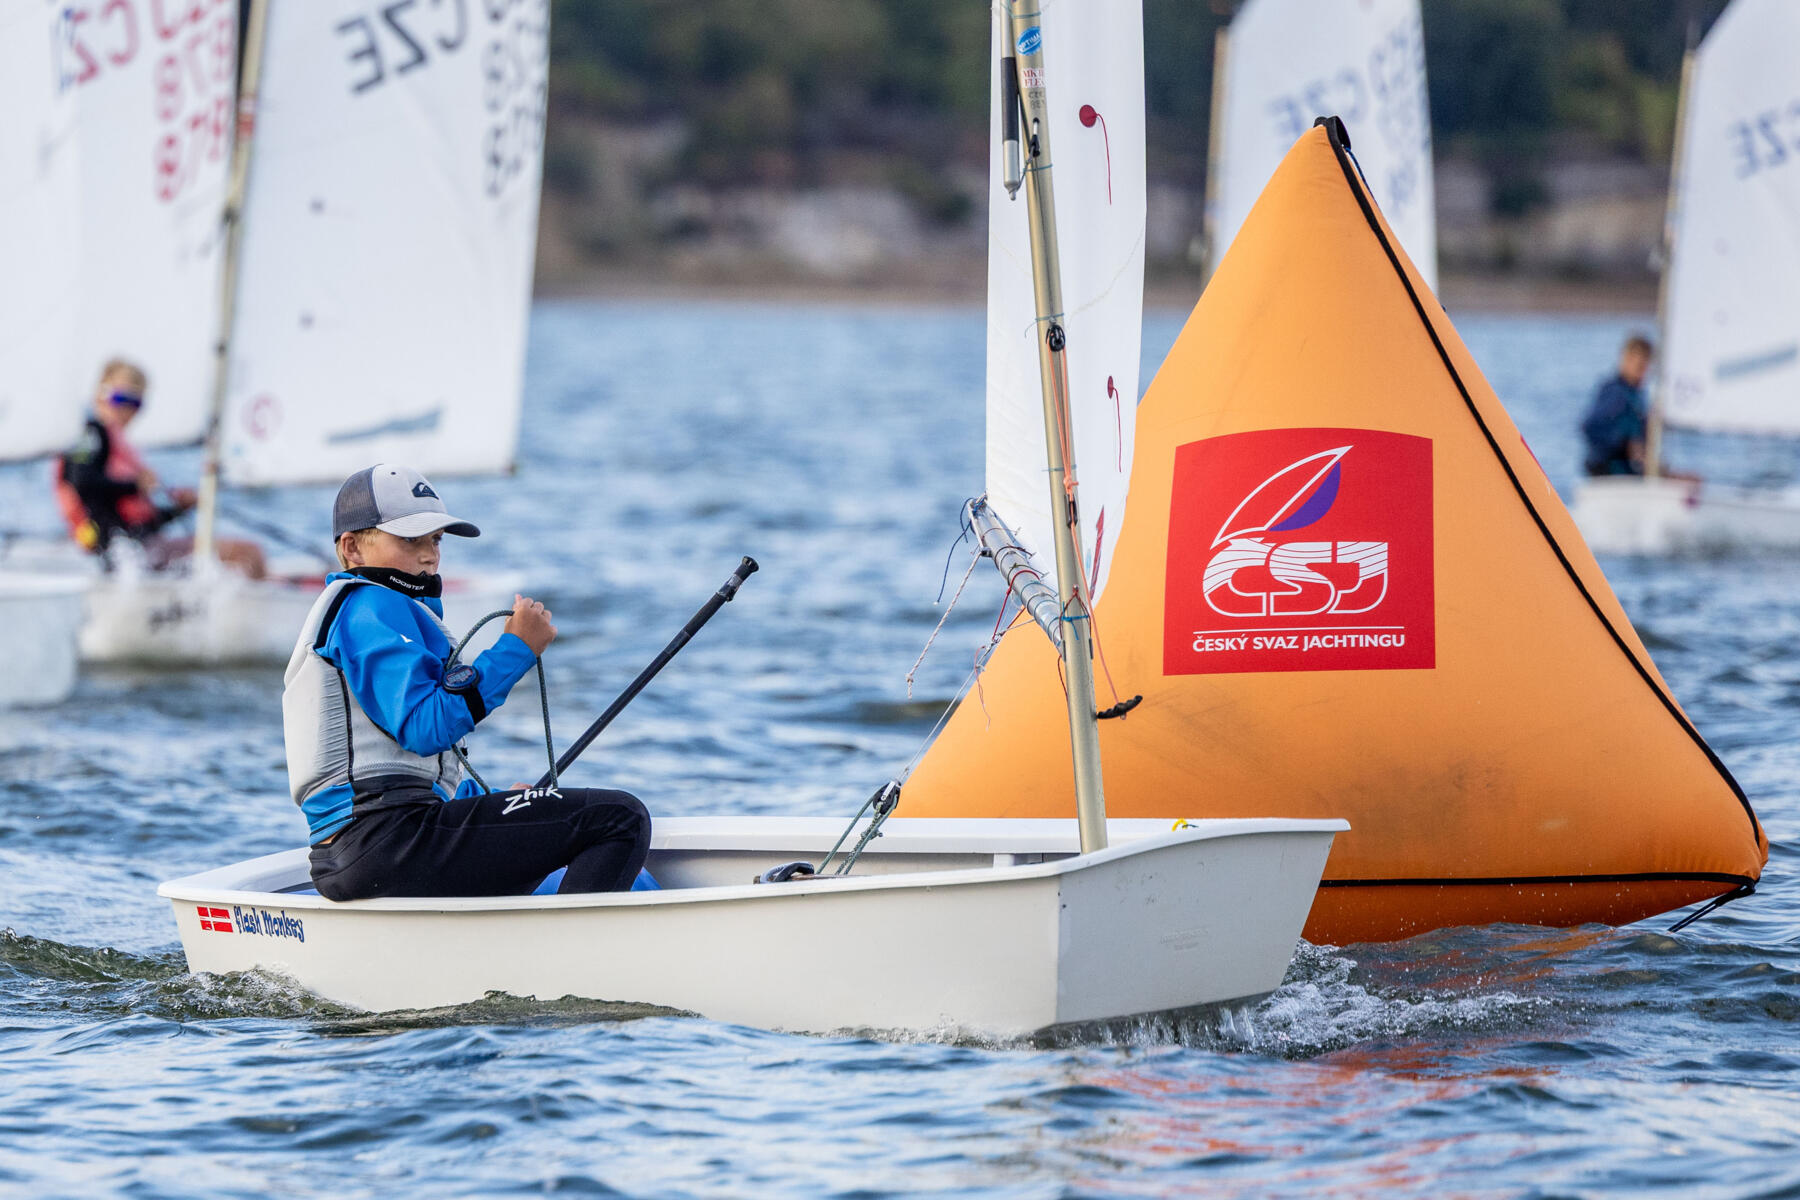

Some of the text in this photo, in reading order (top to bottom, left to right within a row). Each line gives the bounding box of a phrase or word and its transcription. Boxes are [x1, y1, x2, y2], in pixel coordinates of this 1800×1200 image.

[390, 575, 425, 590] ROOSTER
[1193, 633, 1405, 652] ČESKÝ SVAZ JACHTINGU
